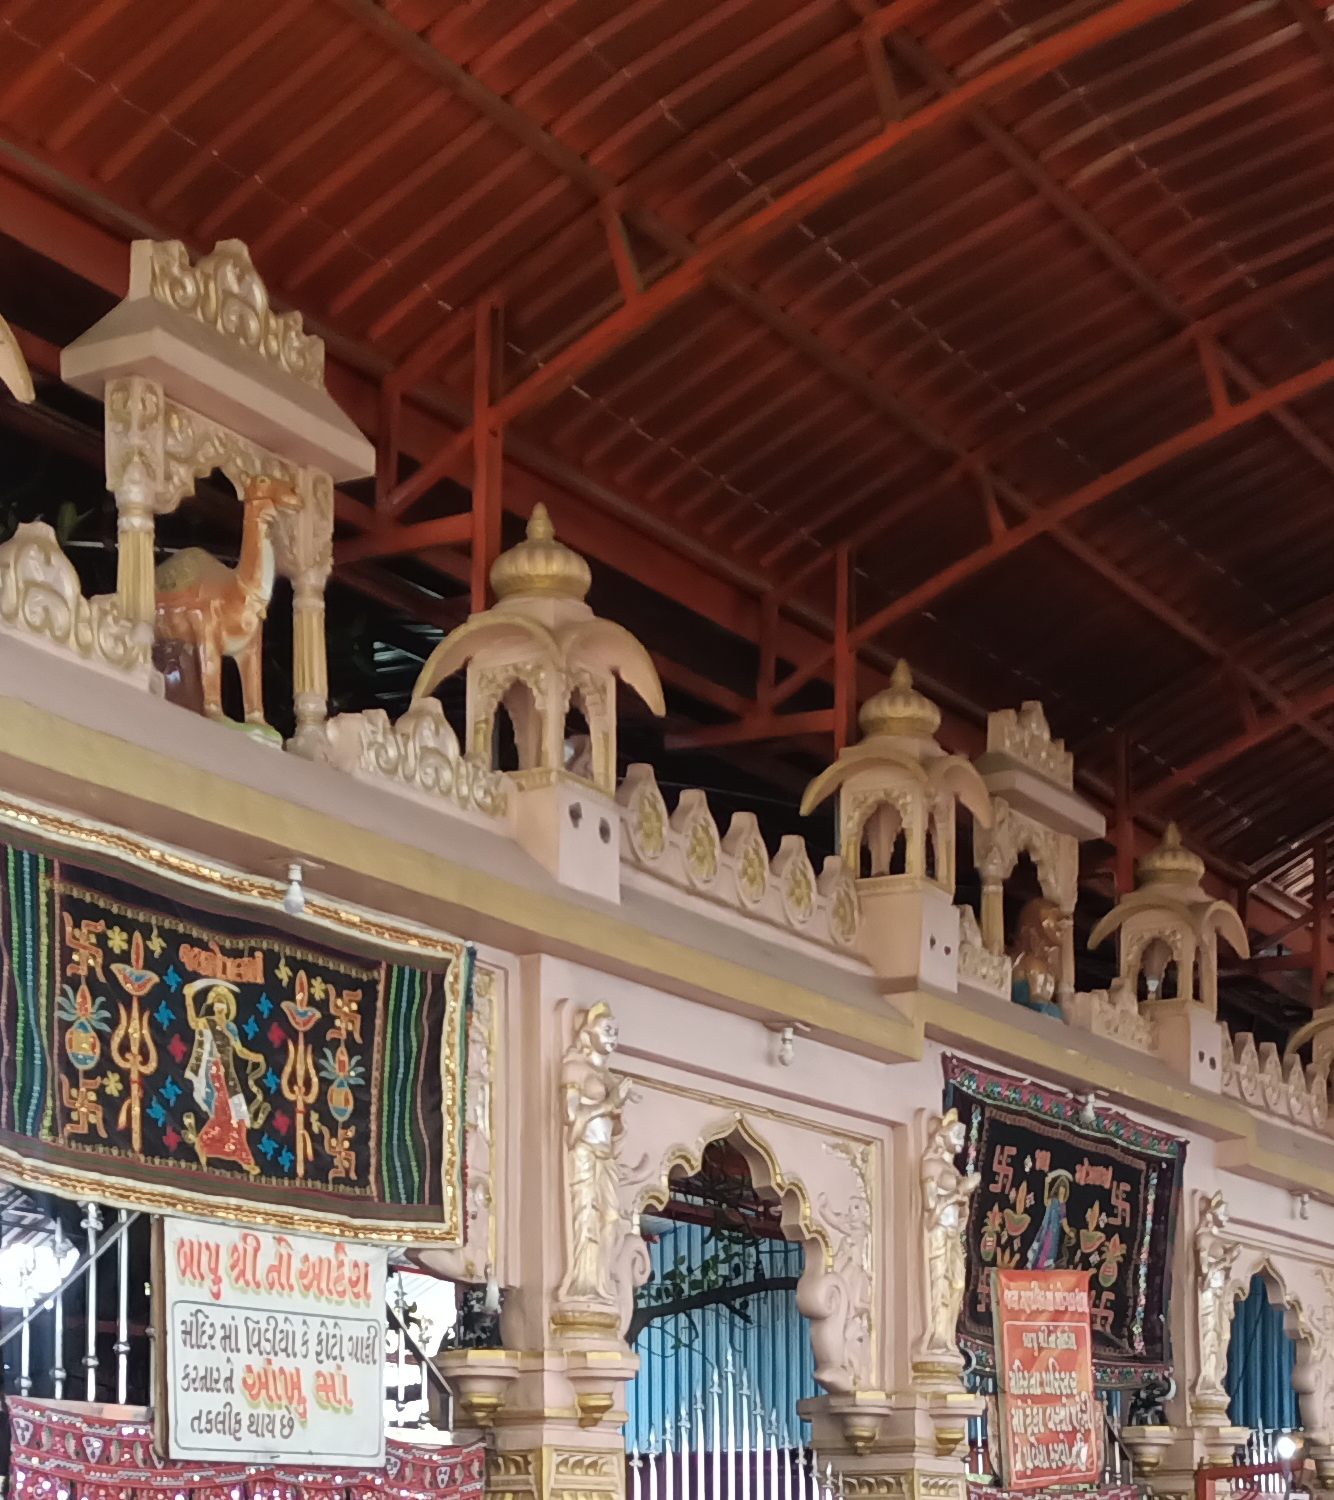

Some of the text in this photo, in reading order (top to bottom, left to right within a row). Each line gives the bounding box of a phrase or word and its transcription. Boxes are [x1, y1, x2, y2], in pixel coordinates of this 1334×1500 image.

[176, 1237, 223, 1301] બાપુ
[228, 1232, 262, 1290] શ્રી
[180, 1308, 217, 1350] મંદિર
[220, 1315, 241, 1355] માં
[300, 1320, 311, 1360] કે
[190, 1402, 295, 1441] તકલીફ થાય છે
